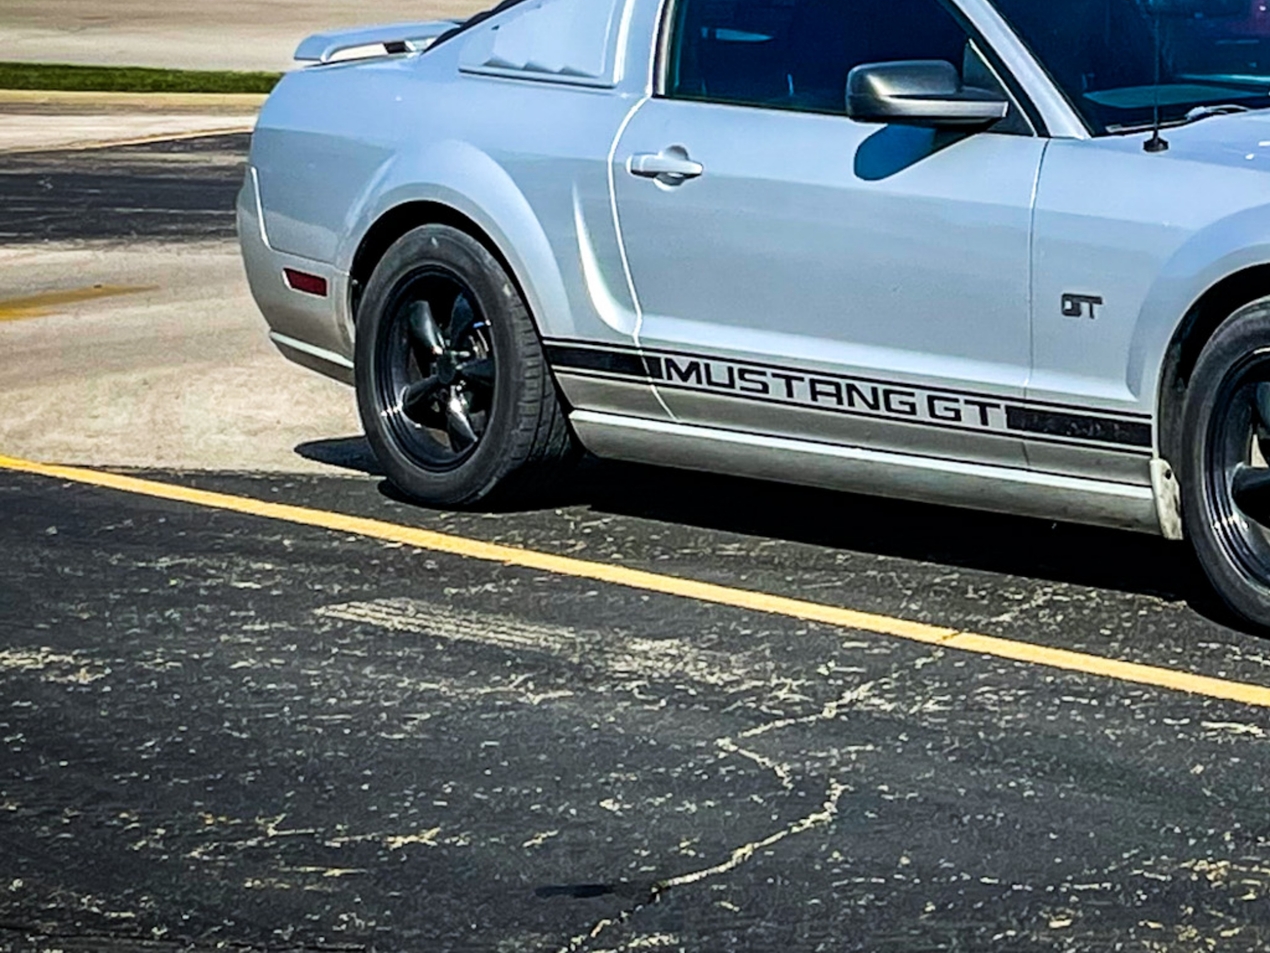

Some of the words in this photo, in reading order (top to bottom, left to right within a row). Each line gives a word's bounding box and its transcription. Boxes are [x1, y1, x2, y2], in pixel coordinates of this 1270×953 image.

[1061, 293, 1103, 320] GT
[664, 356, 917, 416] MUSTANG
[927, 395, 1008, 429] GT
